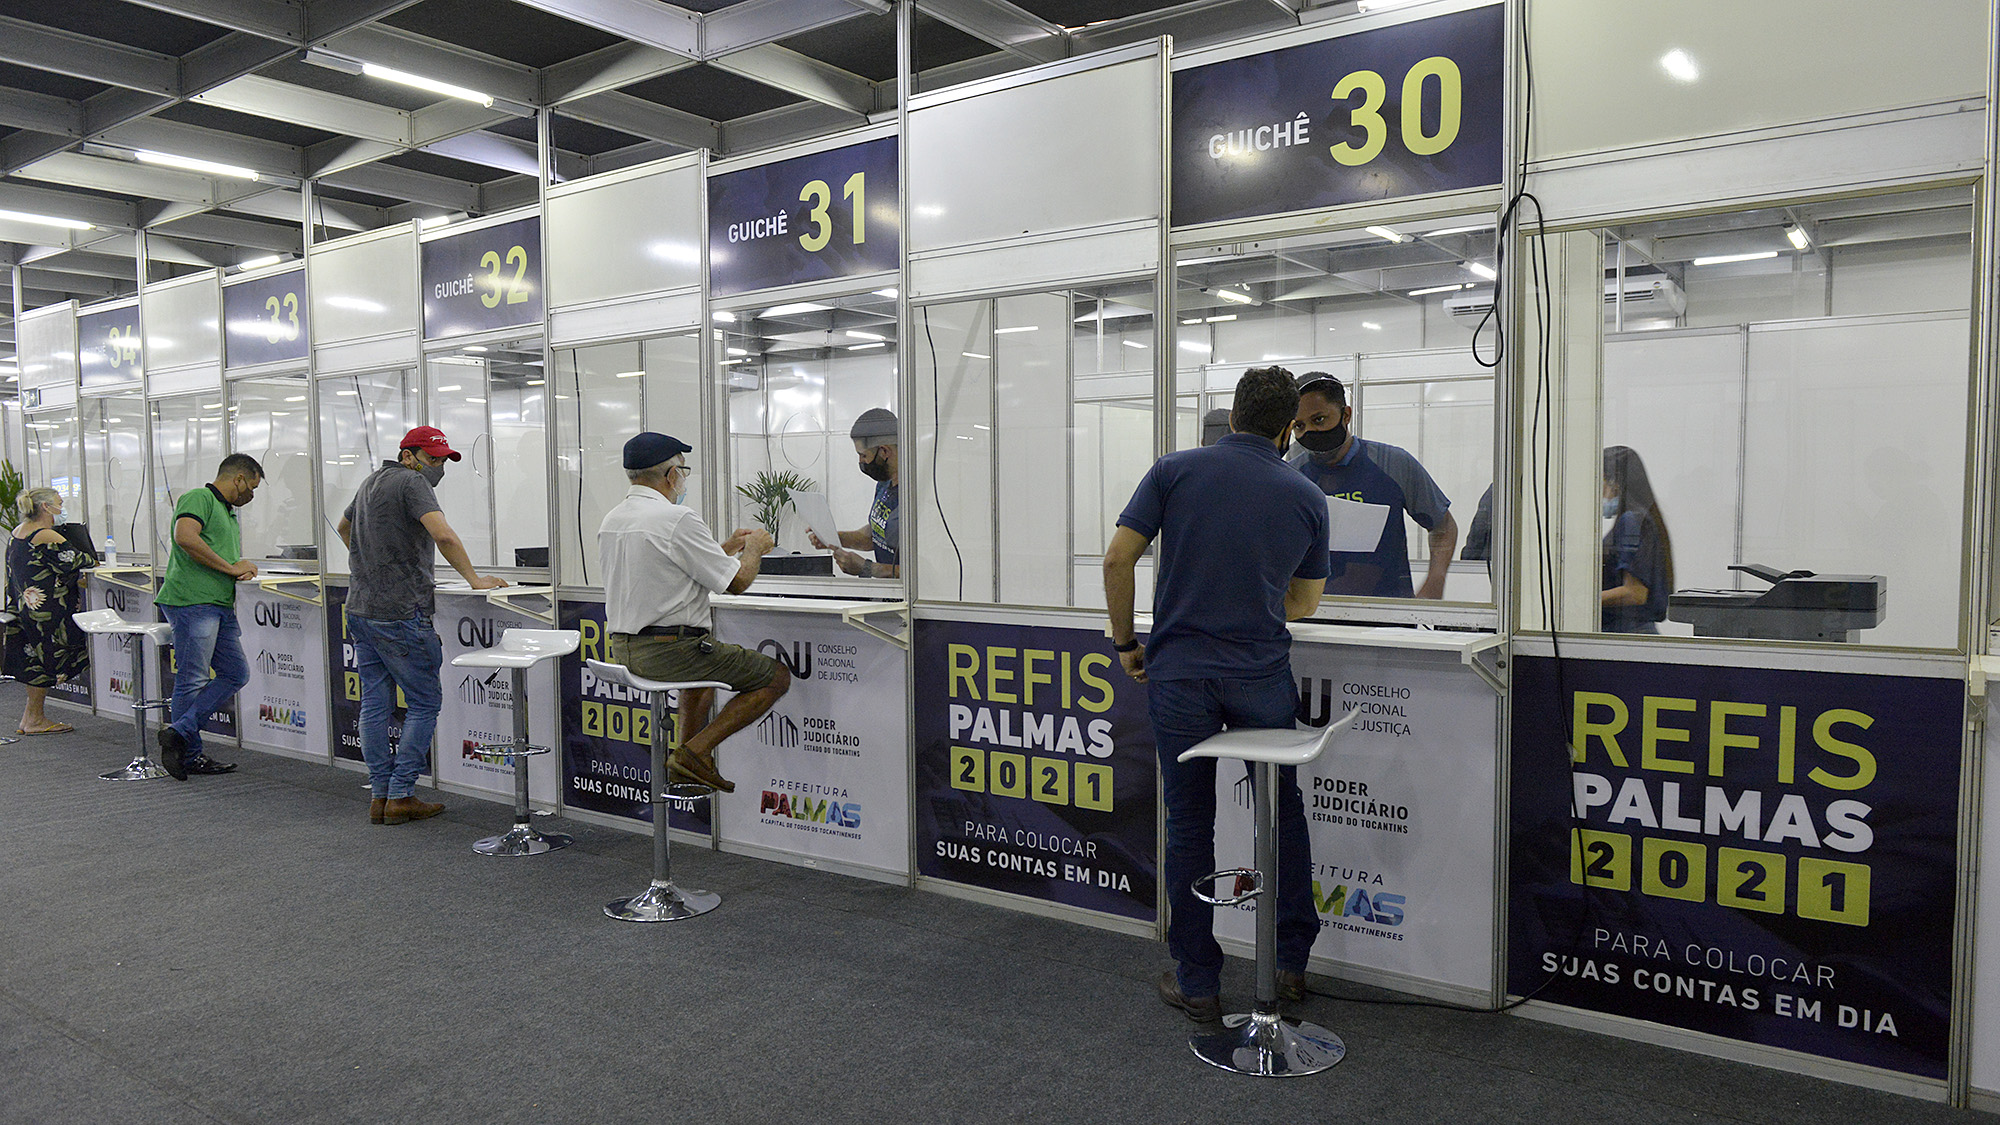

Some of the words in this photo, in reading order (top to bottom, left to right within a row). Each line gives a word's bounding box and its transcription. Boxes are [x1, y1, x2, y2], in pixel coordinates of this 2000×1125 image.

[1208, 111, 1310, 159] GUICHÊ
[1329, 56, 1462, 166] 30
[728, 209, 788, 243] GUICHÊ
[799, 171, 865, 252] 31
[435, 273, 474, 299] GUICHÊ
[480, 245, 528, 308] 32
[265, 292, 299, 344] 33
[109, 325, 136, 368] 34
[817, 644, 857, 655] CONSELHO
[818, 657, 855, 668] NACIONAL
[581, 667, 679, 709] PALS
[818, 671, 828, 680] DE
[829, 672, 858, 684] JUSTIÇA
[948, 643, 1115, 713] REFIS
[488, 690, 514, 702] JUDICIÁ
[1342, 683, 1411, 699] CONSELHO
[219, 712, 230, 723] DIA
[259, 703, 306, 728] PALMAS
[1342, 701, 1408, 718] NACIONAL
[803, 717, 836, 730] PODER
[949, 704, 1114, 758] PALMAS
[1361, 720, 1411, 737] JUSTIÇA
[342, 734, 361, 748] SUAS
[468, 730, 512, 743] PREFEITUR
[803, 730, 860, 747] JUDICIÁRIO
[1573, 691, 1878, 791] REFIS
[462, 740, 515, 767] PALMA
[804, 744, 822, 753] ESTADO
[832, 748, 860, 757] TOCANTINS
[591, 760, 619, 777] PARA
[622, 766, 651, 783] COLO
[959, 755, 1100, 802] 2021
[573, 776, 602, 793] SUAS
[605, 783, 650, 803] CONTAS
[771, 778, 848, 798] PREFEITURA
[1313, 776, 1369, 797] PODER
[760, 790, 861, 829] PALMAS
[1312, 795, 1409, 820] JUDICIÁRIO
[1571, 772, 1874, 853] PALMAS
[765, 819, 785, 828] CAPITAL
[794, 823, 810, 832] TODOS
[819, 828, 862, 840] TOCANTINENSES
[1312, 812, 1343, 825] ESTADO
[1346, 817, 1358, 827] DO
[1361, 819, 1409, 834] TOCANTINS
[965, 820, 1009, 844] PARA
[1015, 829, 1097, 859] COLOCAR
[936, 841, 981, 863] SUAS
[987, 850, 1057, 878] CONTAS
[1064, 864, 1090, 885] EM
[1098, 870, 1131, 892] DIA
[1311, 863, 1384, 886] EITURA
[1585, 840, 1847, 913] 2021
[1332, 921, 1404, 942] TOCANTINENSES
[1594, 928, 1671, 961] PARA
[1685, 944, 1836, 989] COLOCAR
[1542, 951, 1620, 984] SUAS
[1633, 969, 1760, 1011] CONTAS
[1774, 994, 1822, 1023] EM
[1838, 1005, 1899, 1037] DIA
